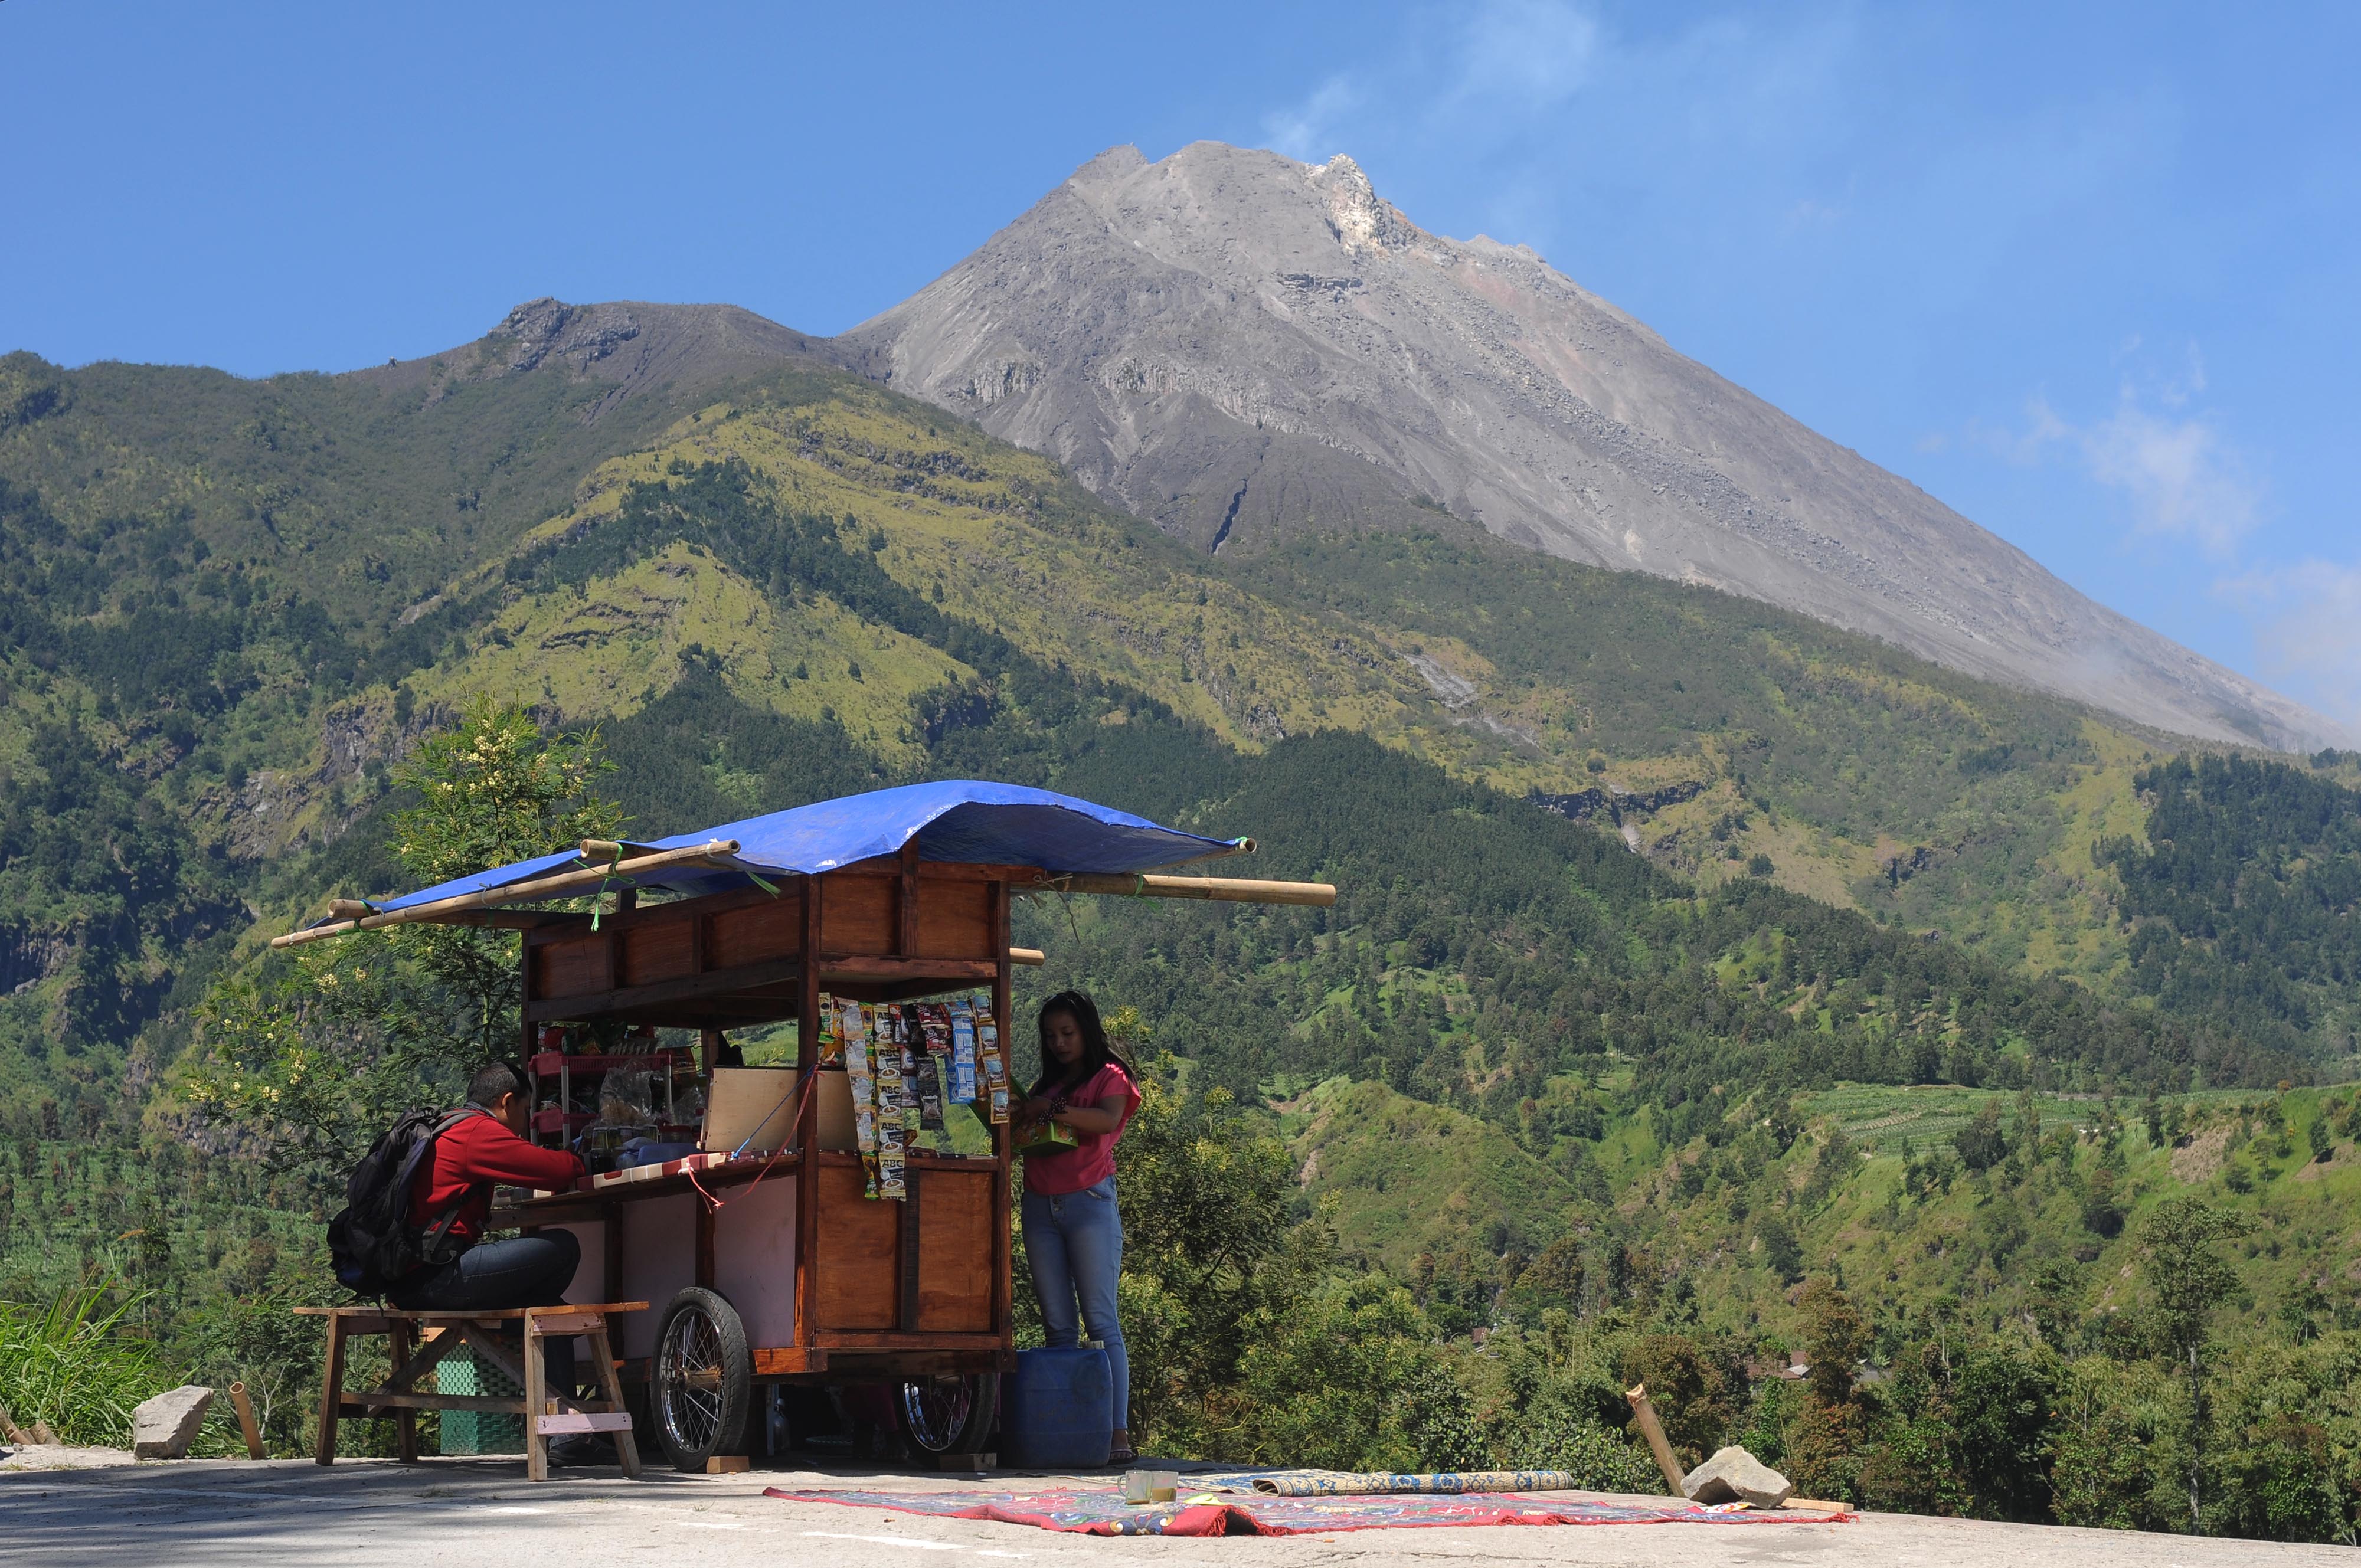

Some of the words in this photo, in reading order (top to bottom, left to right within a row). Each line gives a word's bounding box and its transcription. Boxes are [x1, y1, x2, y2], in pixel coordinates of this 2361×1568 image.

[877, 1012, 889, 1020] AB
[878, 1049, 900, 1057] ABC
[881, 1086, 901, 1094] ABC
[881, 1122, 902, 1131] ABC
[882, 1160, 904, 1168] ABC
